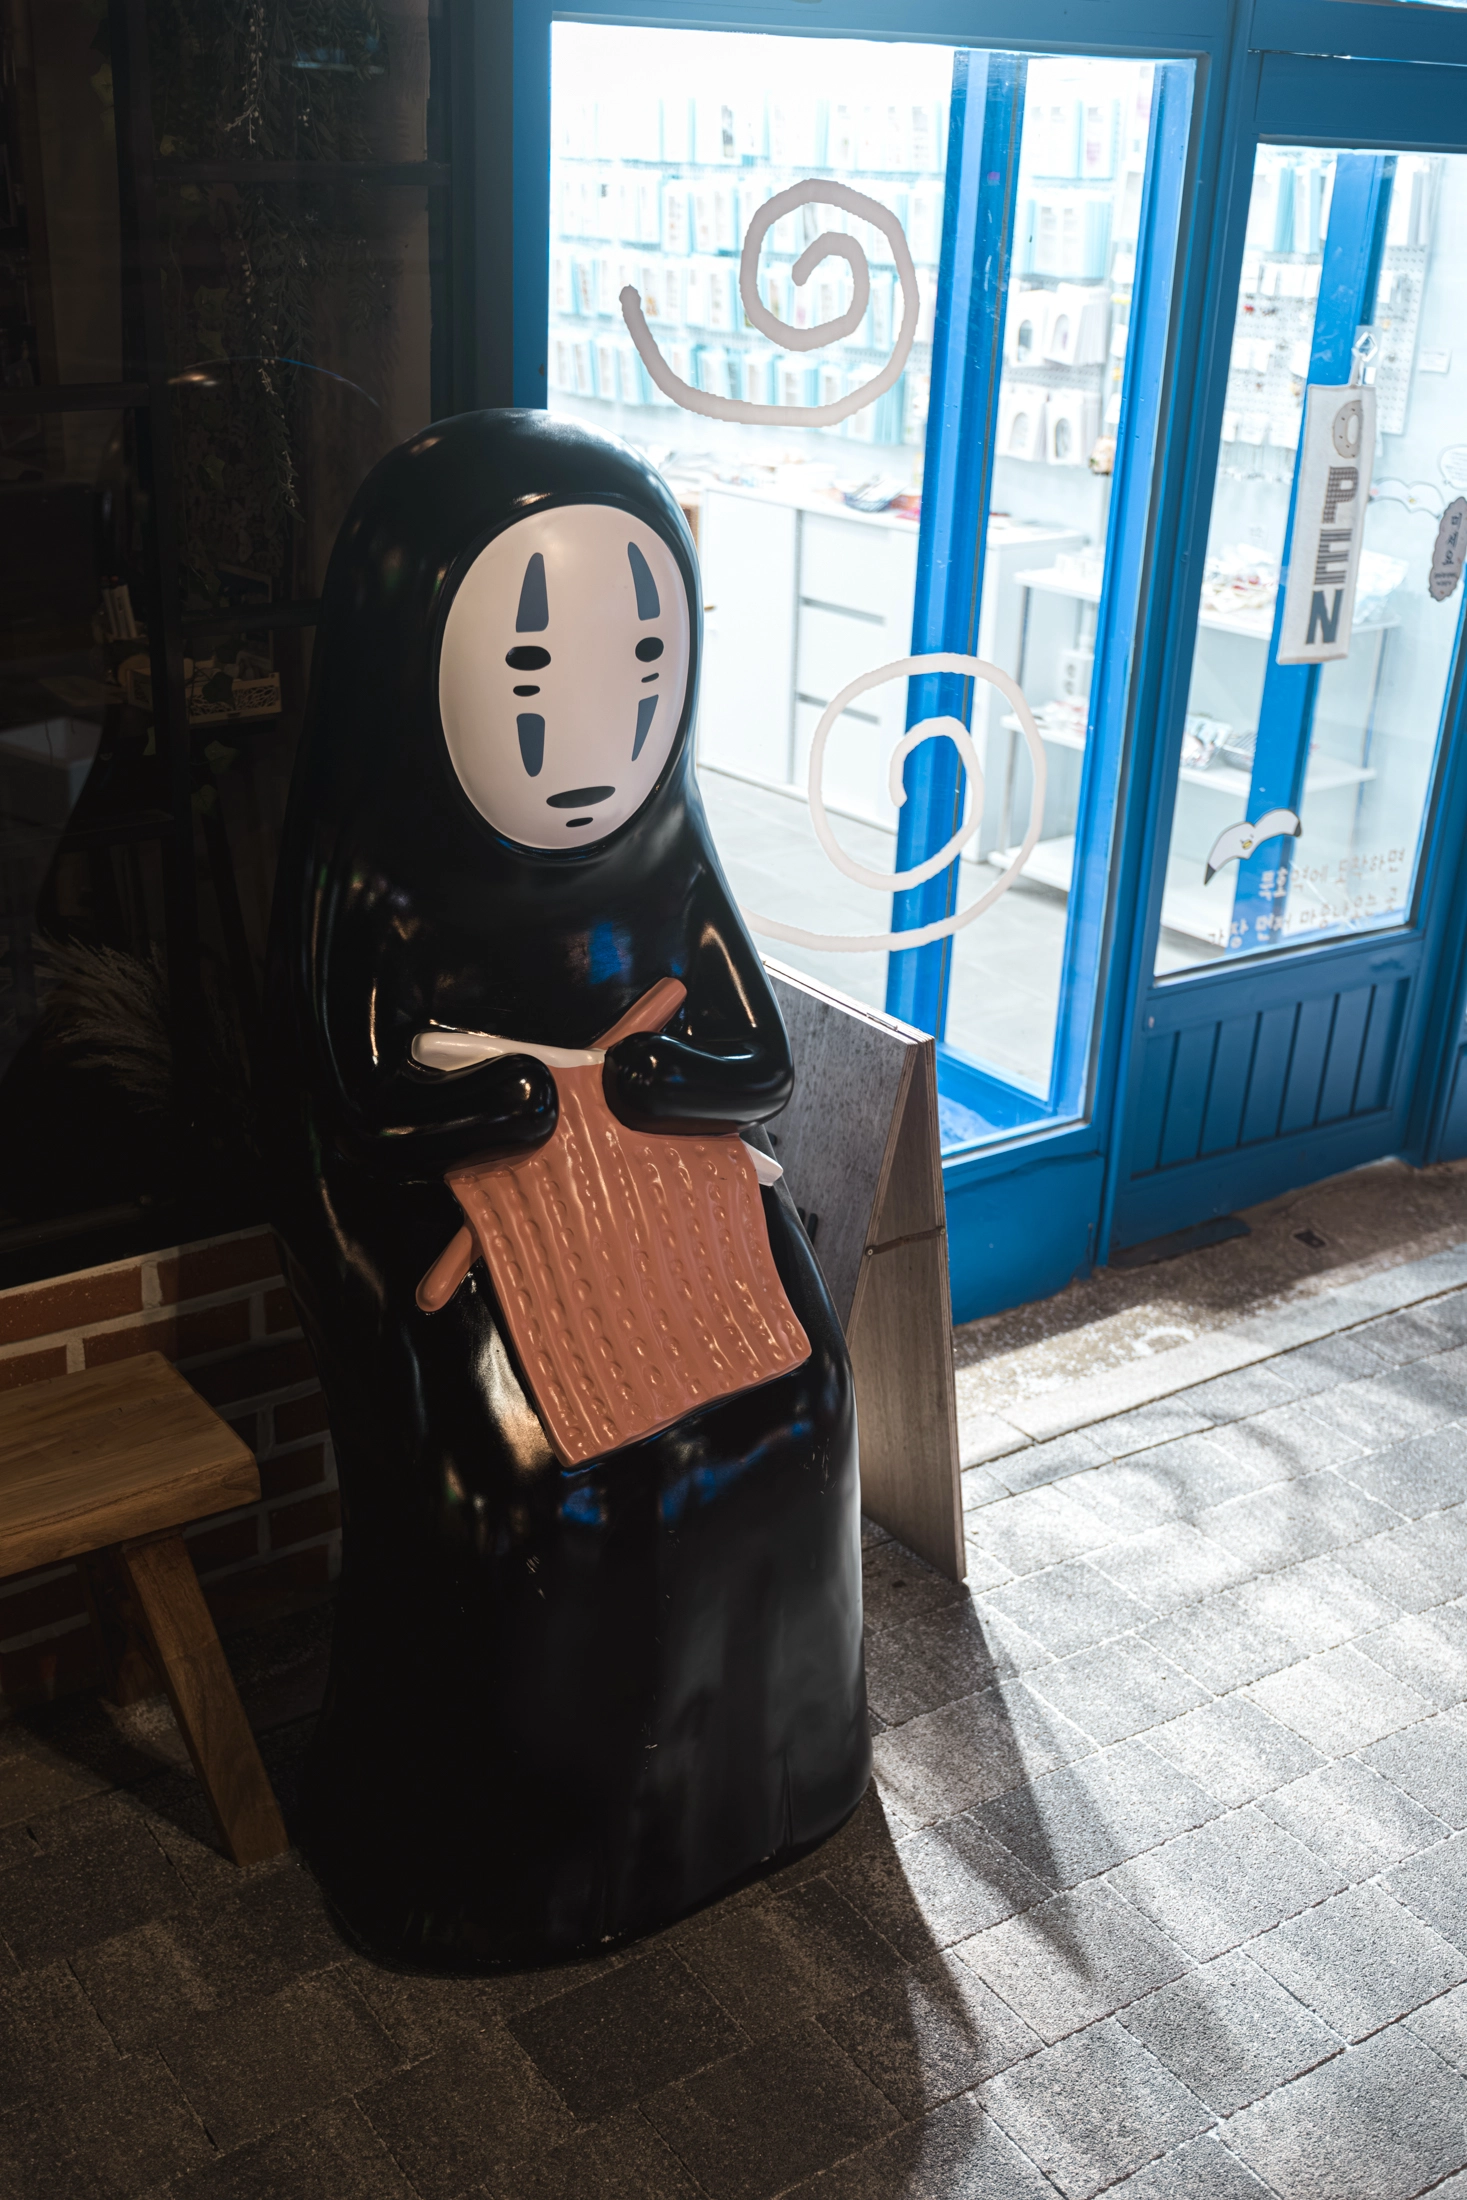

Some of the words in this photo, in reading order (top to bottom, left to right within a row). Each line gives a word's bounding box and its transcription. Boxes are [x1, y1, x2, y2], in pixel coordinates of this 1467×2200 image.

[1305, 399, 1363, 645] OPEN
[1334, 849, 1405, 884] 도착하면
[1208, 919, 1249, 949] 가장
[1255, 914, 1292, 942] 먼저
